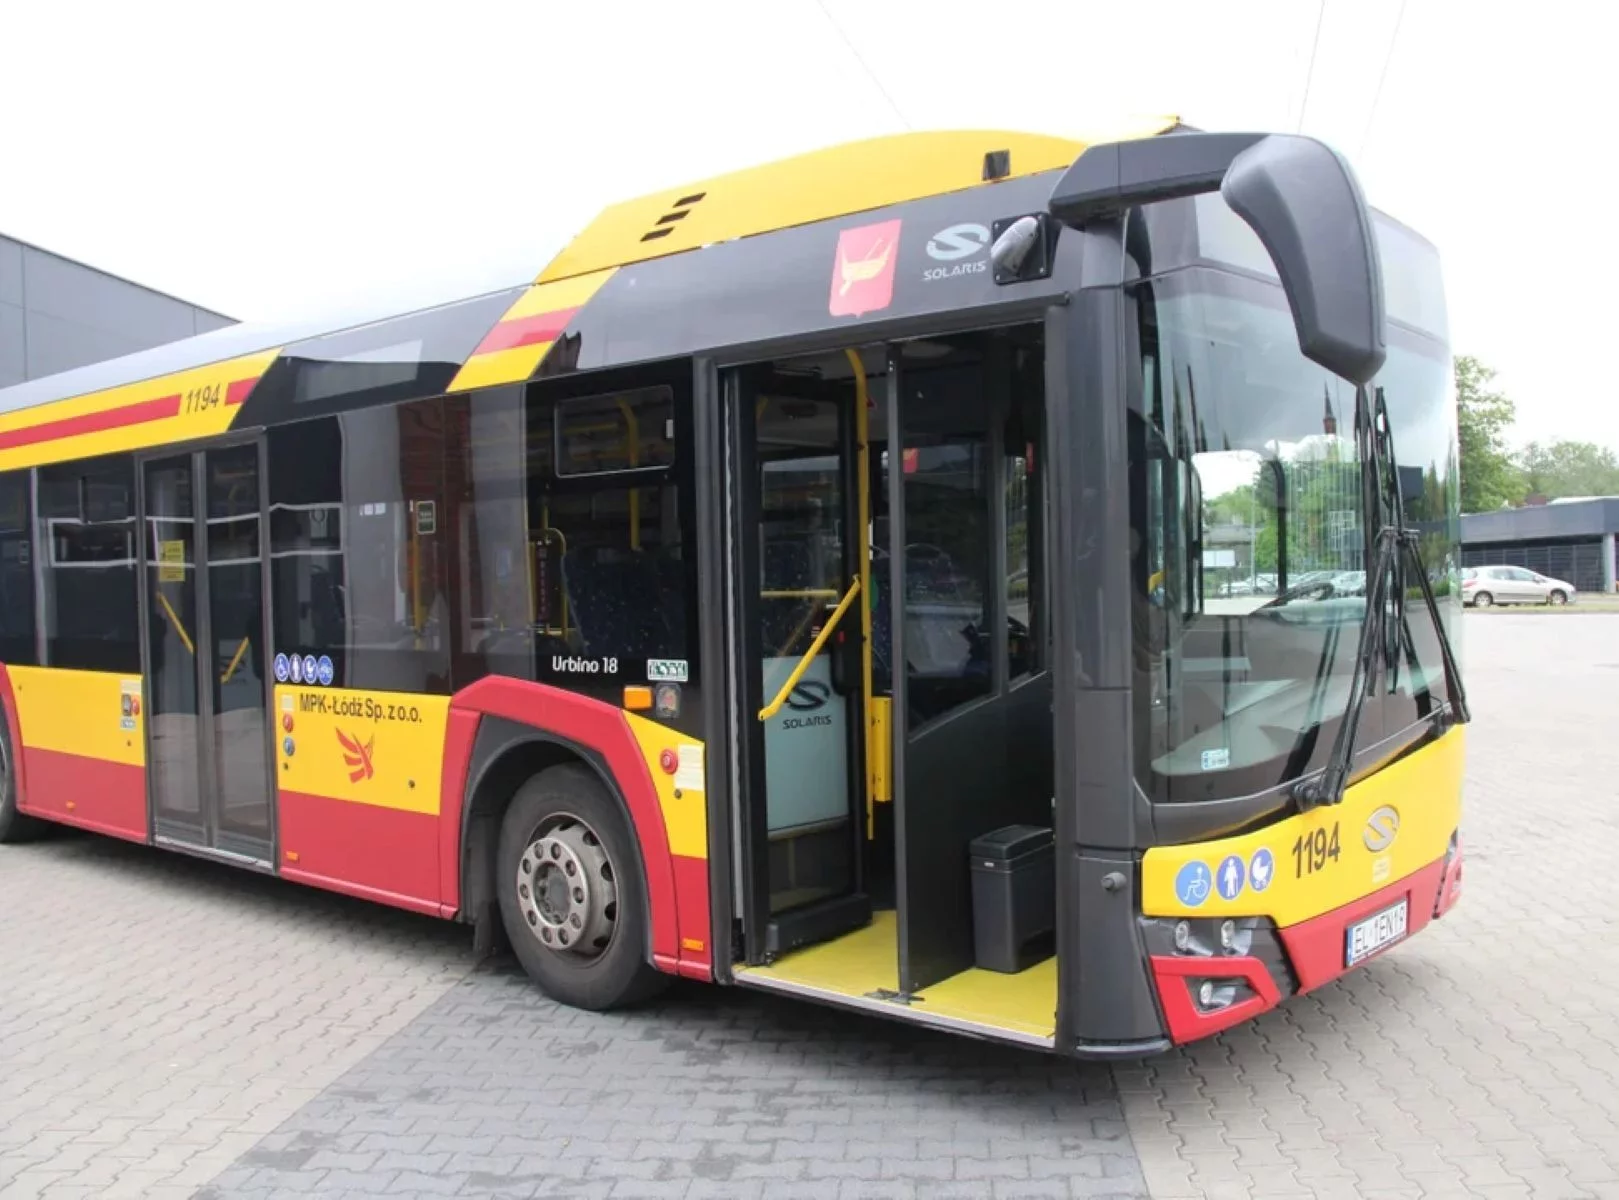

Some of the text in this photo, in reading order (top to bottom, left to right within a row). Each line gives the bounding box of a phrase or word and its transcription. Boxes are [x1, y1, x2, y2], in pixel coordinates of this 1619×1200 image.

[923, 260, 987, 281] SOLARIS
[186, 383, 220, 414] 1194
[552, 655, 618, 673] Urbino 18
[365, 697, 386, 723] Sp.
[782, 715, 832, 730] SOLARIS
[1292, 821, 1341, 879] 1194
